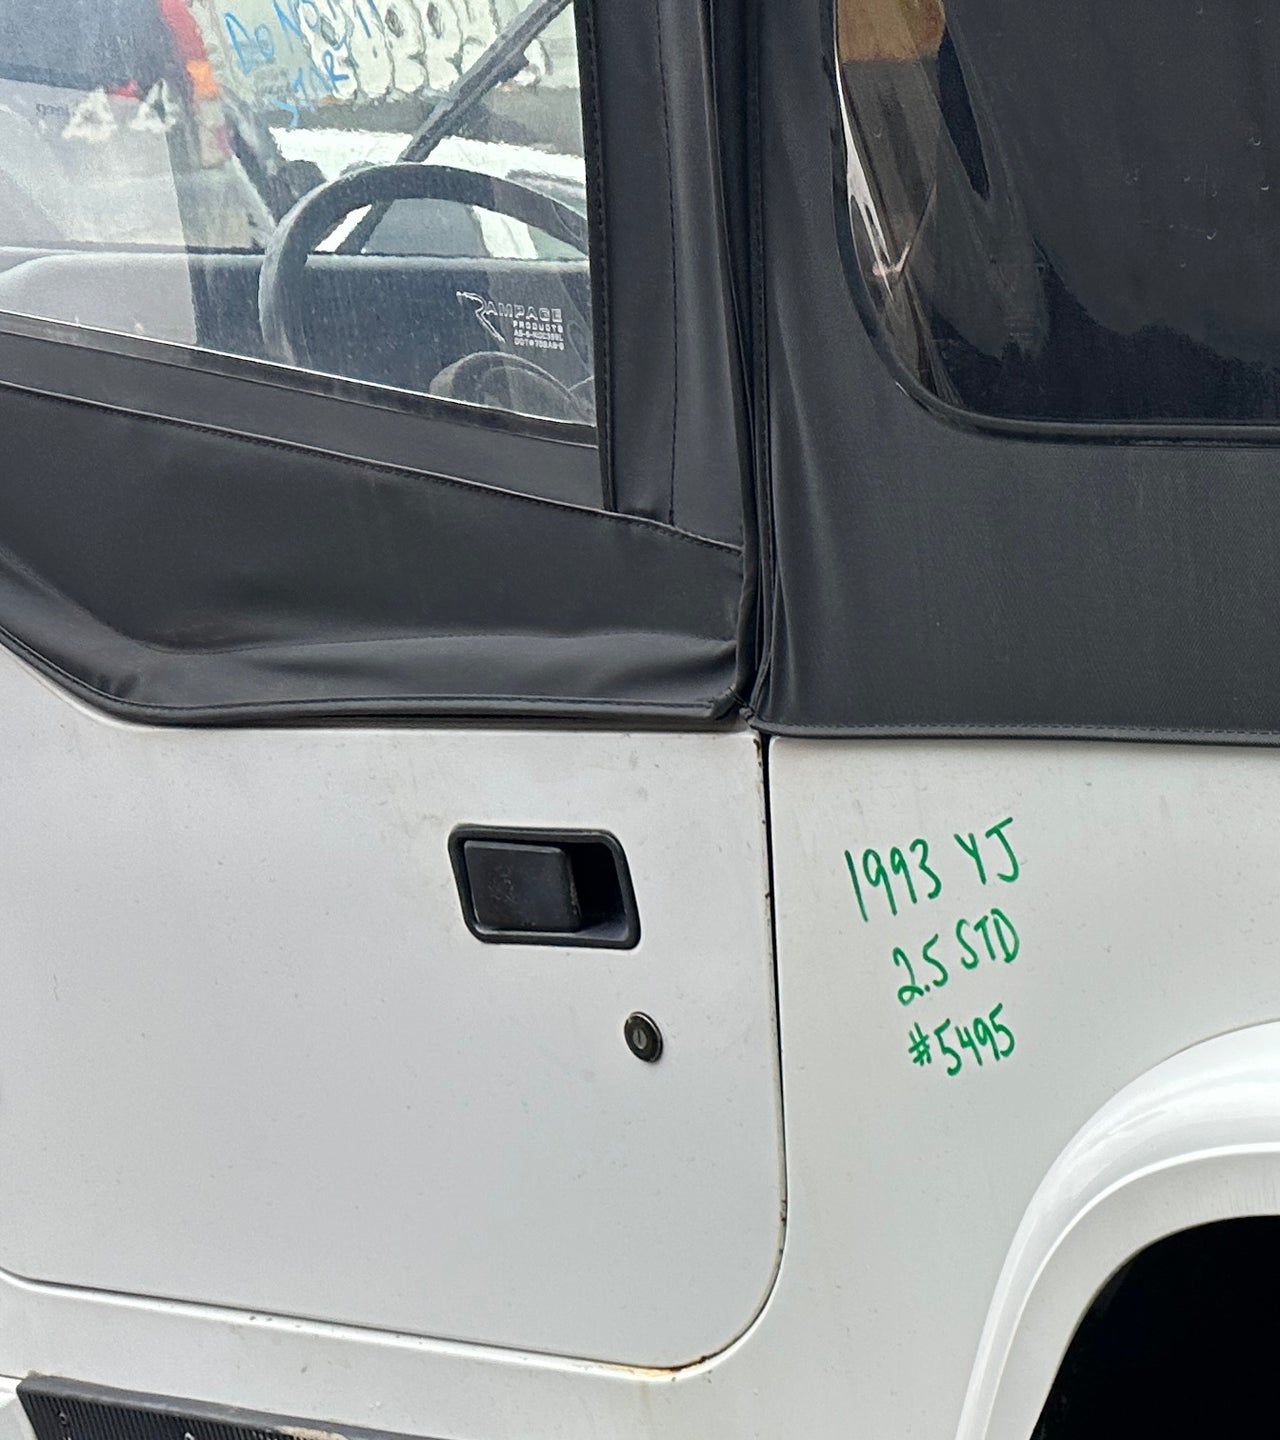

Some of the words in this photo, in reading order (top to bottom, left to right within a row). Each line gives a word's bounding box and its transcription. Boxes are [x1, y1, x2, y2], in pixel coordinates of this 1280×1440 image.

[456, 291, 563, 343] RAMPAGE
[513, 320, 564, 334] PRODUCTS
[844, 838, 942, 922] 1993
[953, 817, 1020, 885] YJ
[892, 933, 949, 1006] 2.5
[955, 907, 1020, 970] STD
[908, 1002, 1015, 1076] #5495
